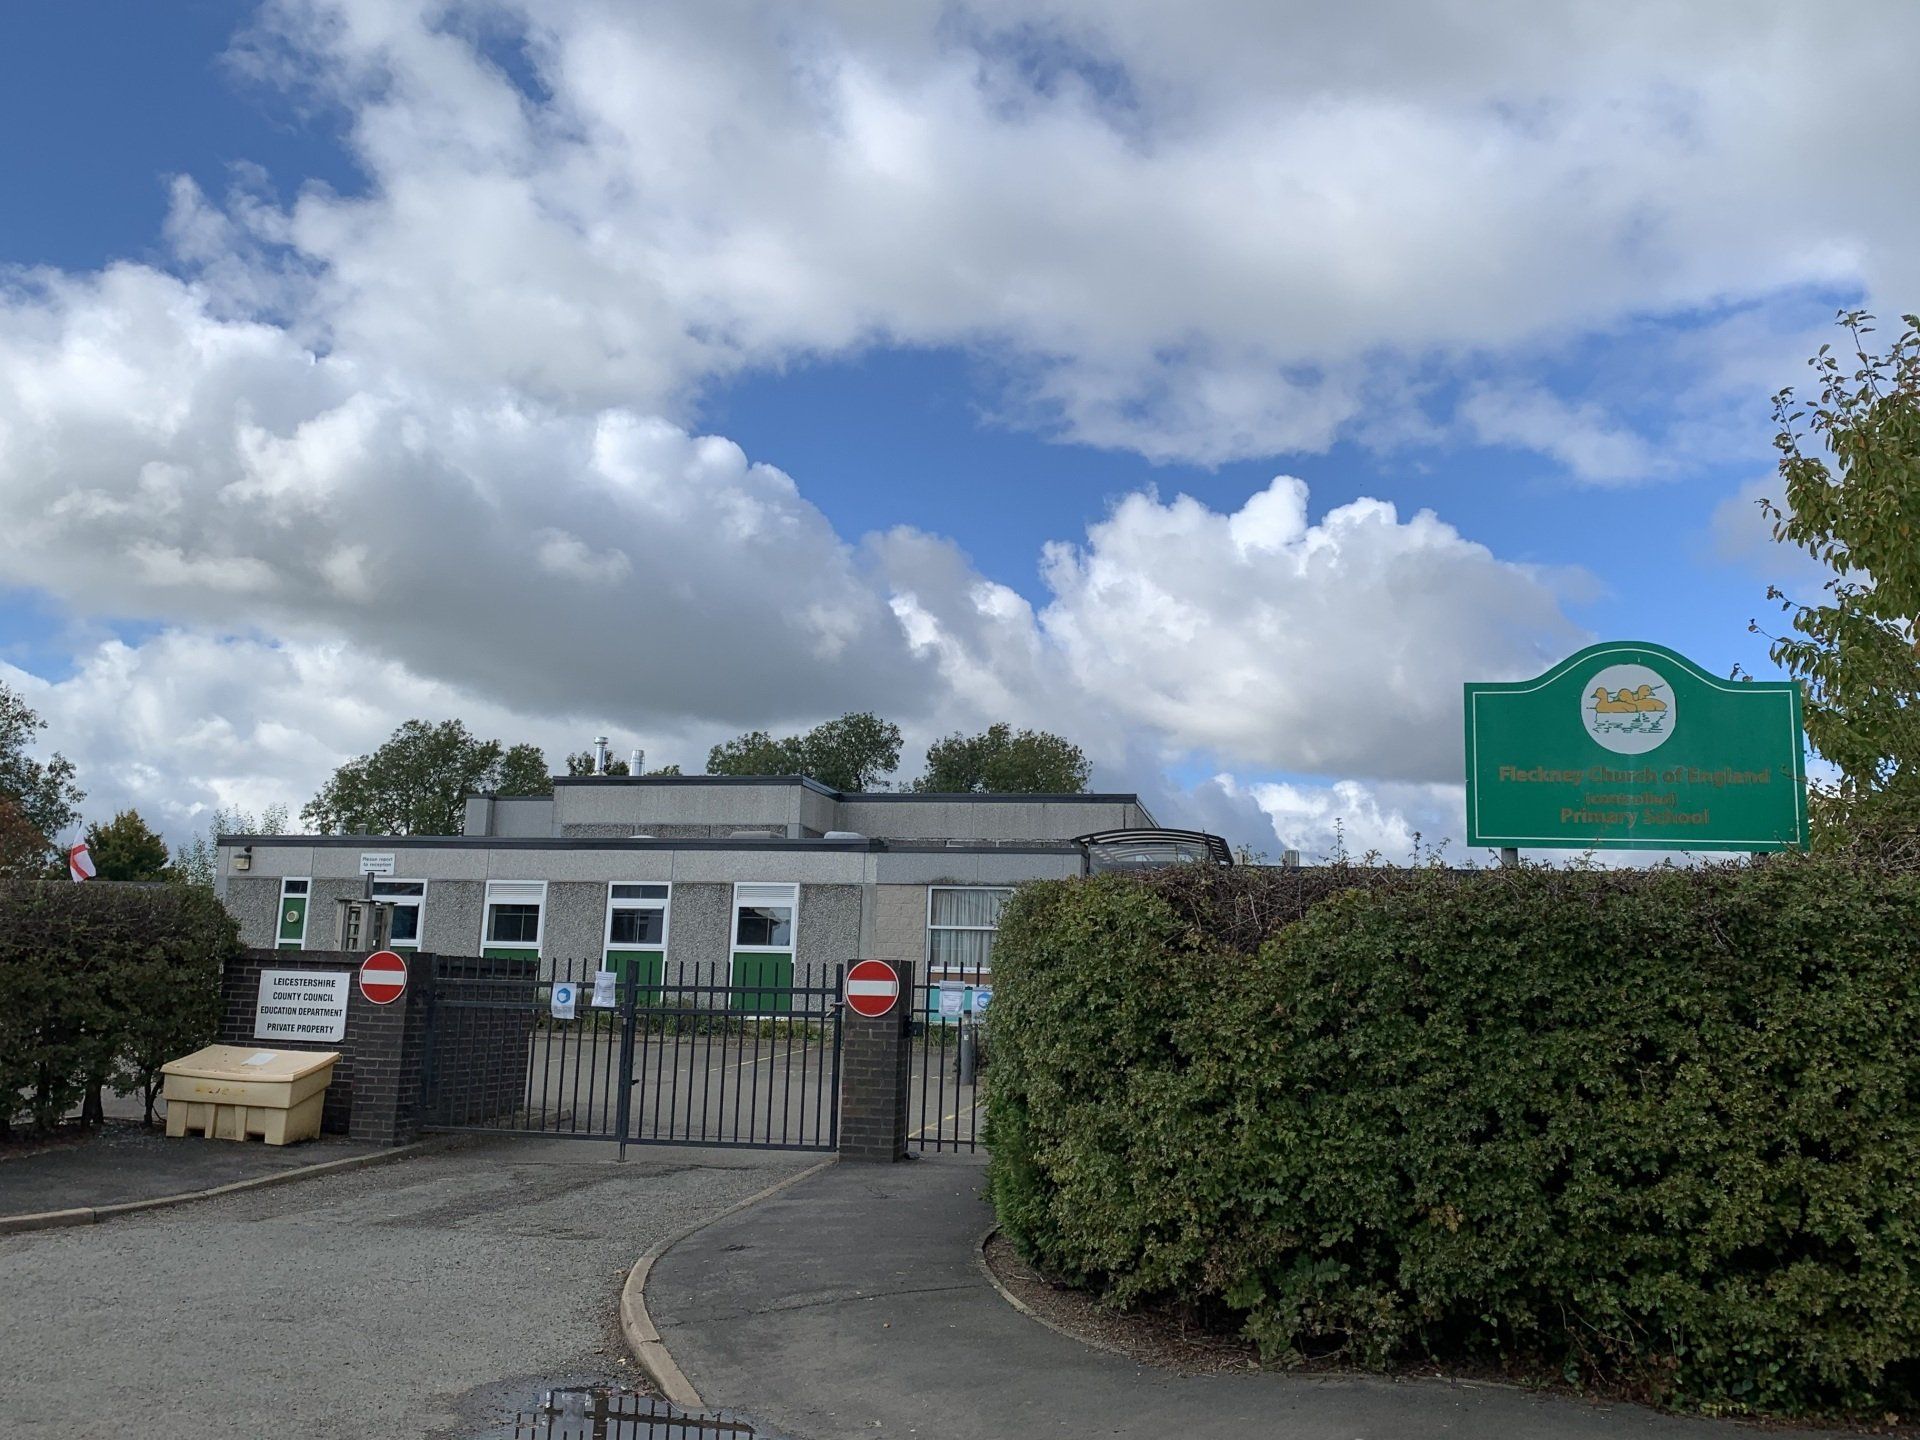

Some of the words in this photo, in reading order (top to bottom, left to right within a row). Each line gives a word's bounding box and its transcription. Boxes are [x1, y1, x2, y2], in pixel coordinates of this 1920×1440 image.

[1499, 766, 1583, 786] Fleckney
[1588, 766, 1657, 784] Church
[1662, 766, 1685, 783] of
[1688, 768, 1770, 788] England
[1560, 808, 1638, 829] Primary
[1643, 808, 1710, 825] School
[273, 977, 336, 988] LEICESTERSHIRE
[272, 991, 301, 1001] COUNTY
[303, 992, 334, 1002] COUNCIL
[260, 1005, 297, 1015] EDUCATION
[298, 1007, 343, 1017] DEPARTMENT
[266, 1022, 295, 1032] PRIVATE
[296, 1024, 334, 1034] PROPERTY
